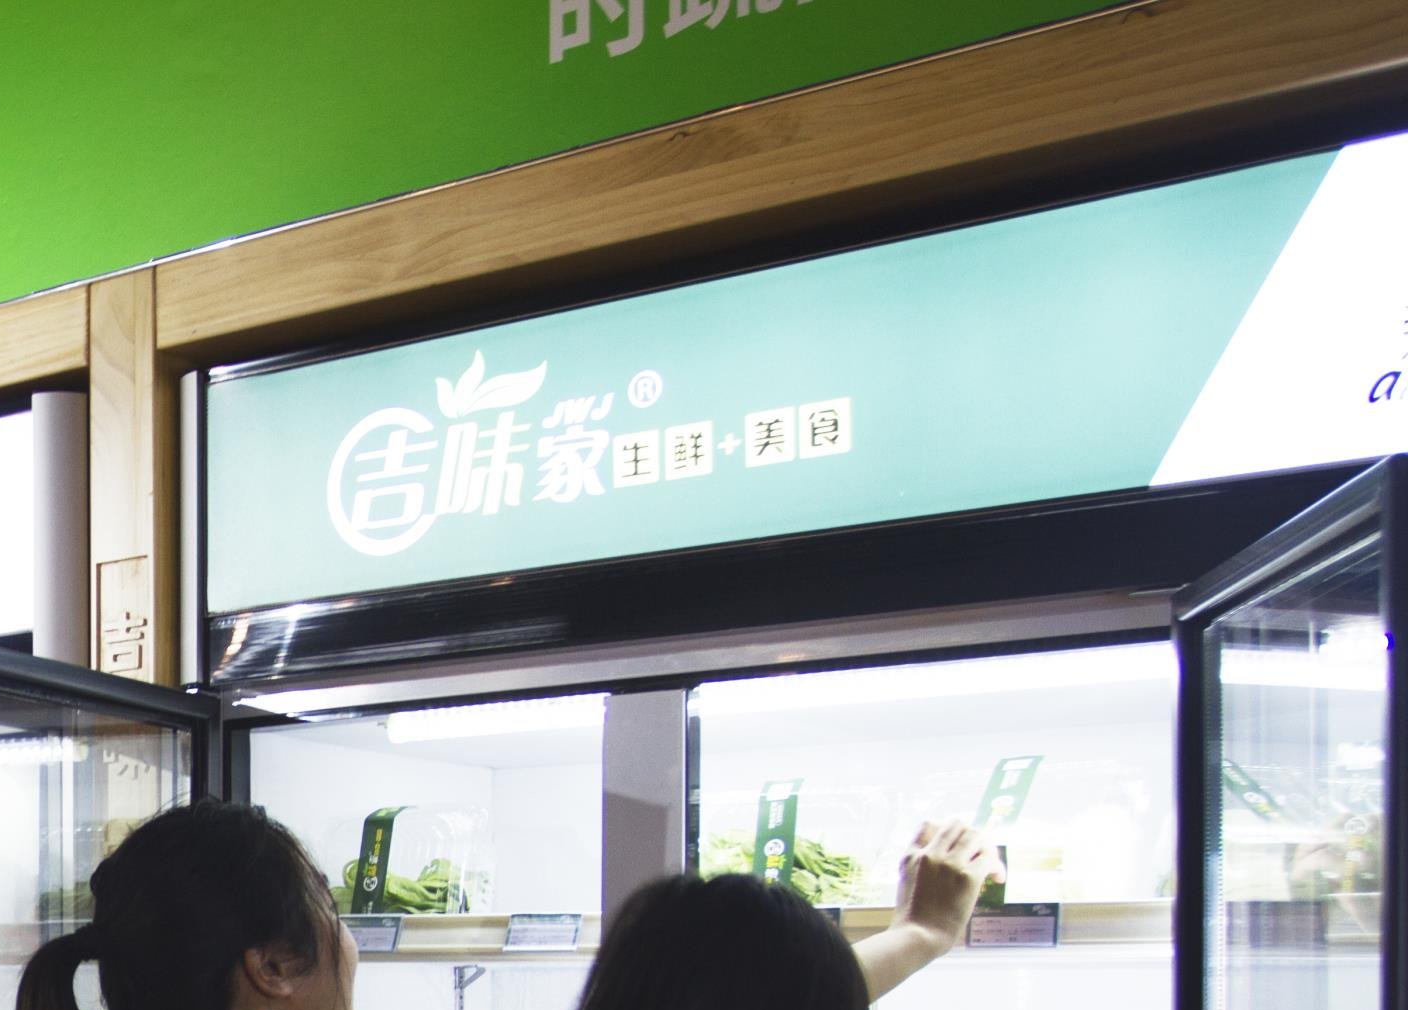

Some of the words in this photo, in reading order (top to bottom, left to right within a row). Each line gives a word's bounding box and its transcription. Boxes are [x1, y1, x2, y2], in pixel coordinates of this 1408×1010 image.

[542, 392, 615, 429] JWJ
[327, 408, 612, 557] 吉味家
[613, 397, 852, 489] 生鲜+美食
